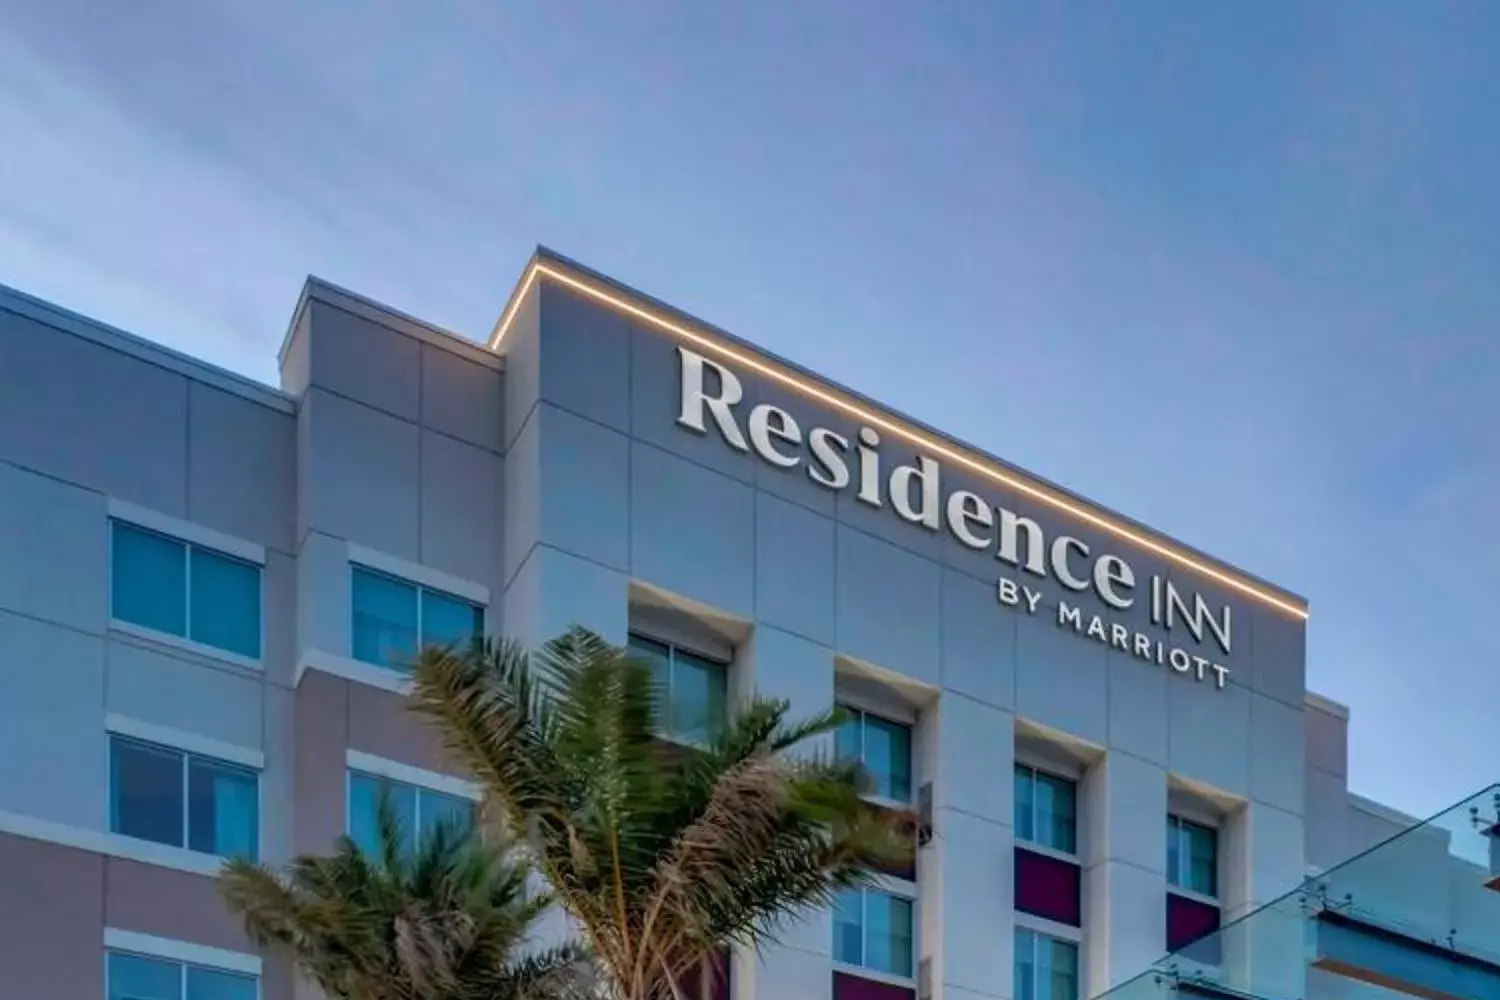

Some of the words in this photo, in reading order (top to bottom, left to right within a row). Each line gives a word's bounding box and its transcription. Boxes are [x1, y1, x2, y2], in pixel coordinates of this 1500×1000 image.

[675, 345, 1136, 609] Residence
[1152, 574, 1232, 656] INN
[998, 576, 1043, 614] BY
[1058, 600, 1231, 690] MARRIOTT
